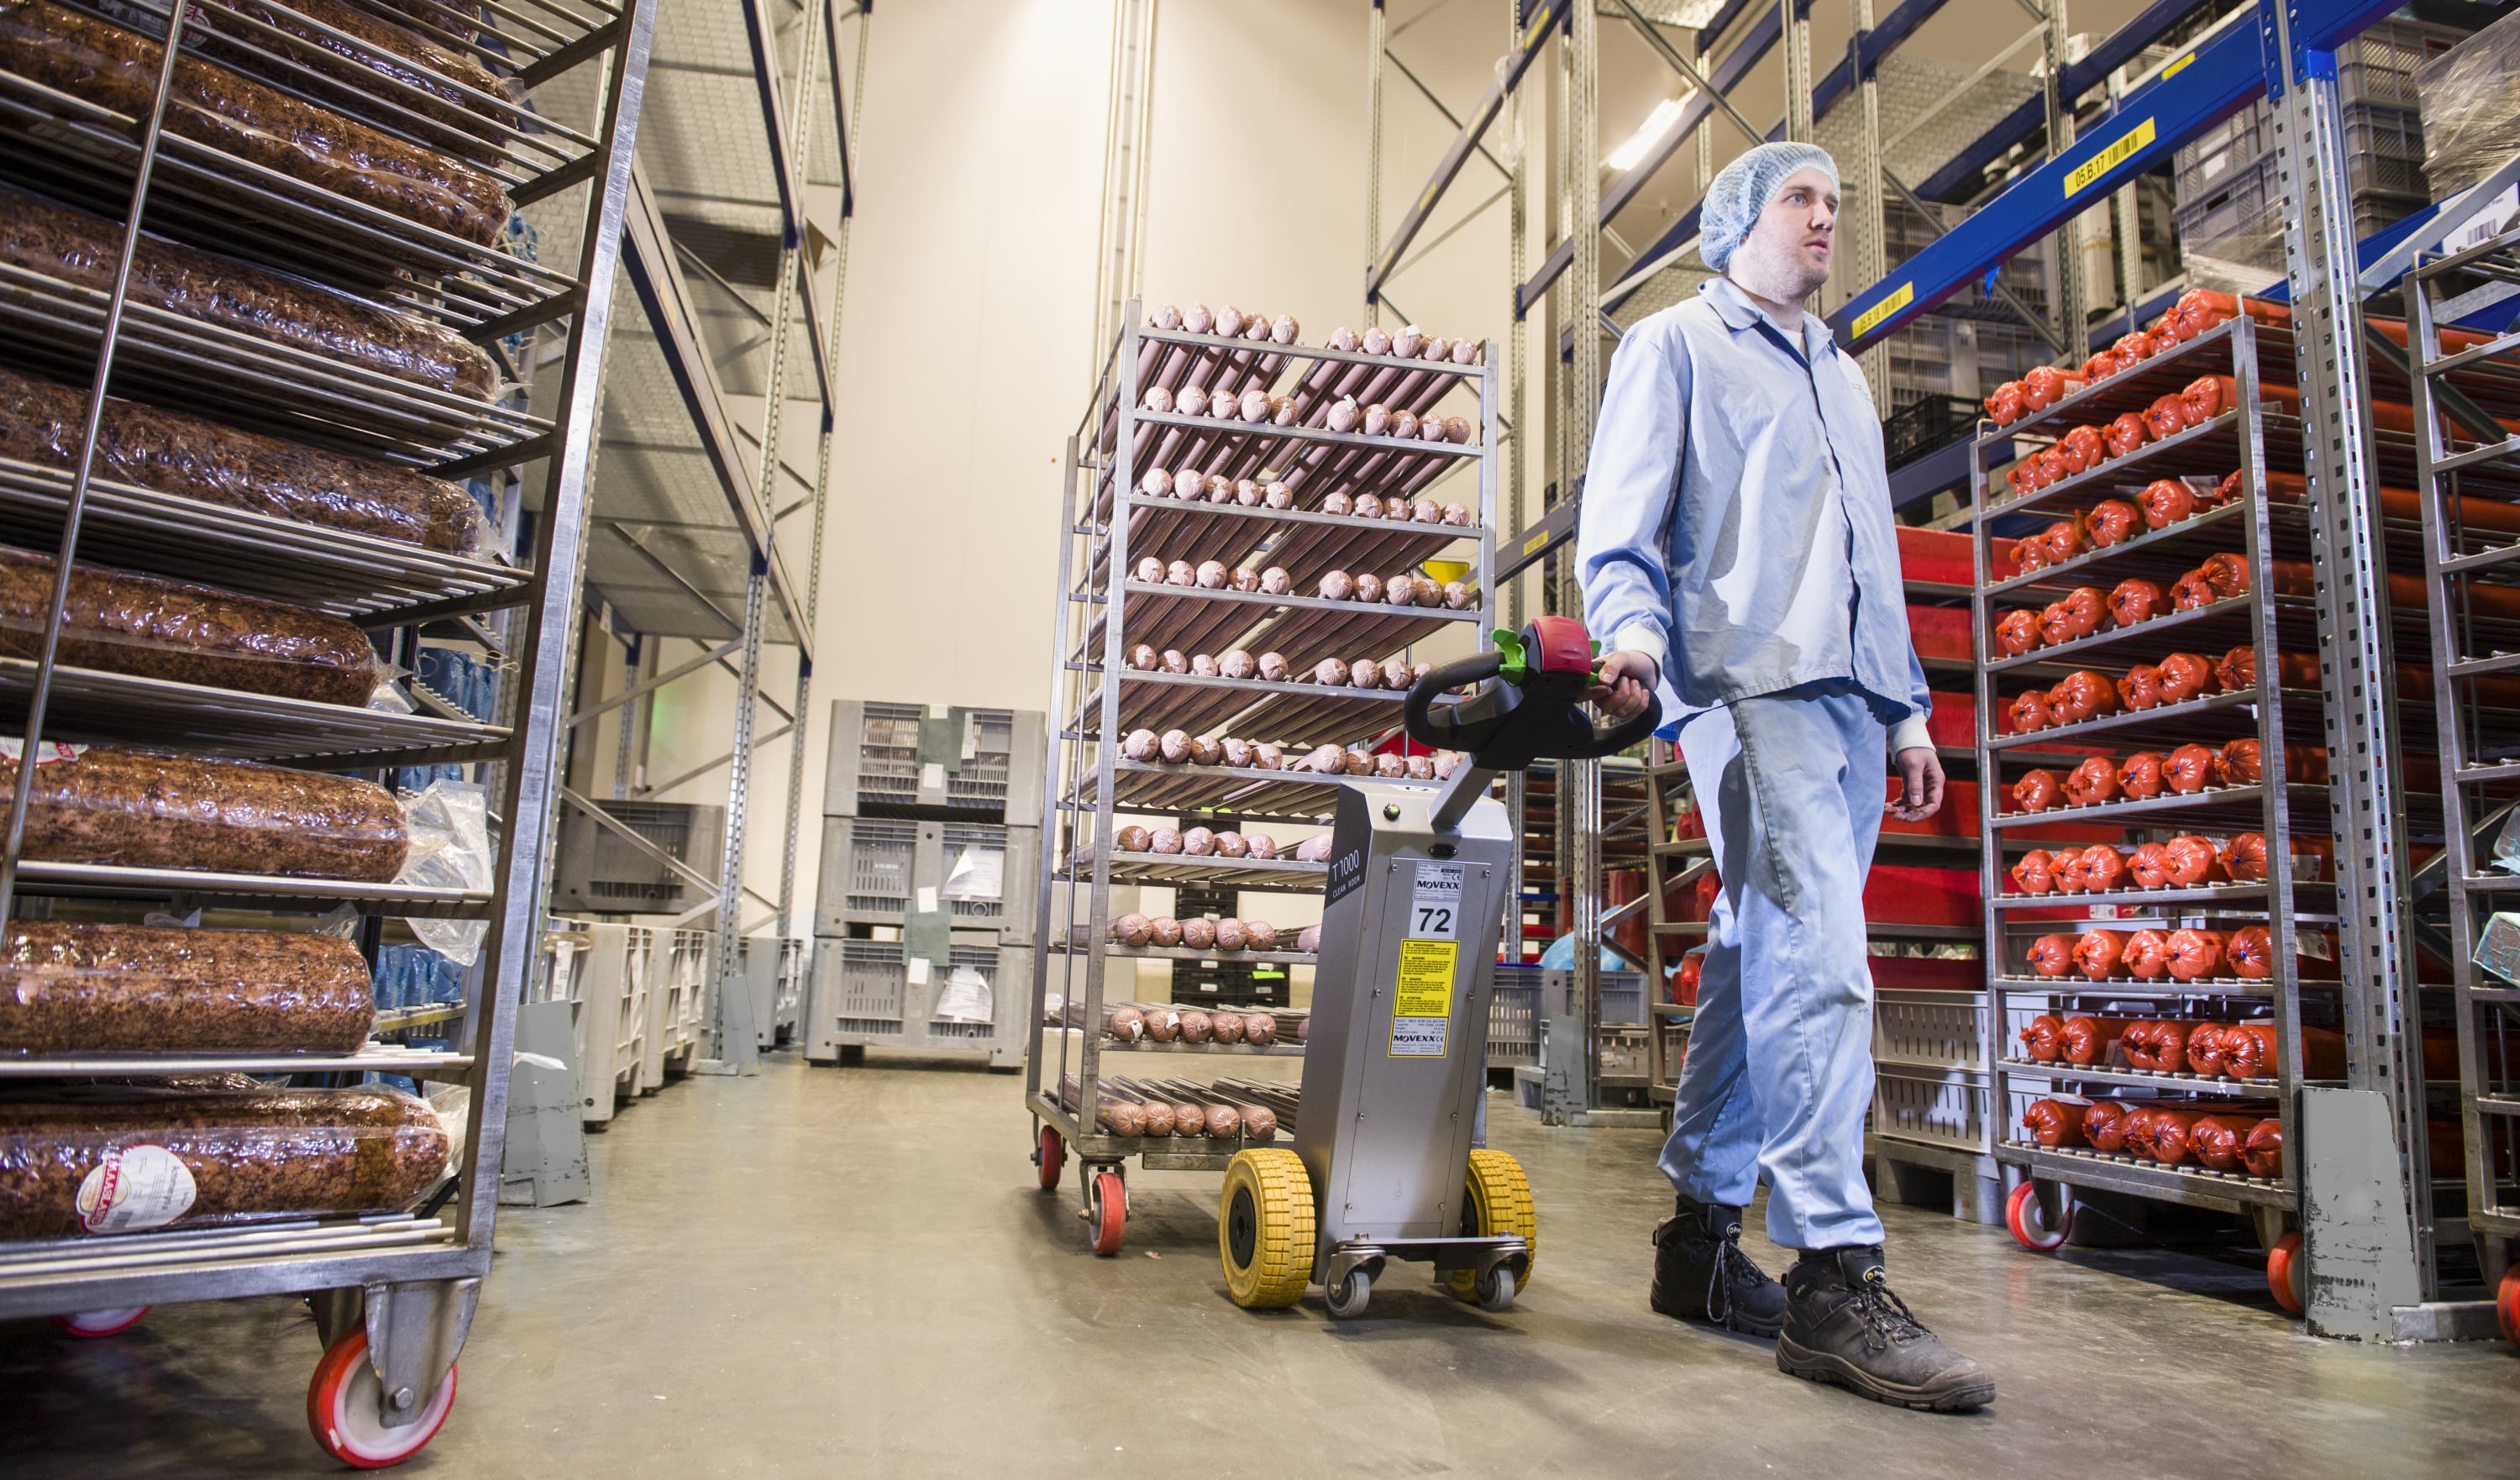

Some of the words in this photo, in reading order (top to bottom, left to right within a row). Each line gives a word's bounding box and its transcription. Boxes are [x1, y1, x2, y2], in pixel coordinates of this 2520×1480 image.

[2076, 154, 2105, 187] 05.B.17
[1417, 880, 1460, 890] MOVEXX
[1419, 908, 1451, 932] 72
